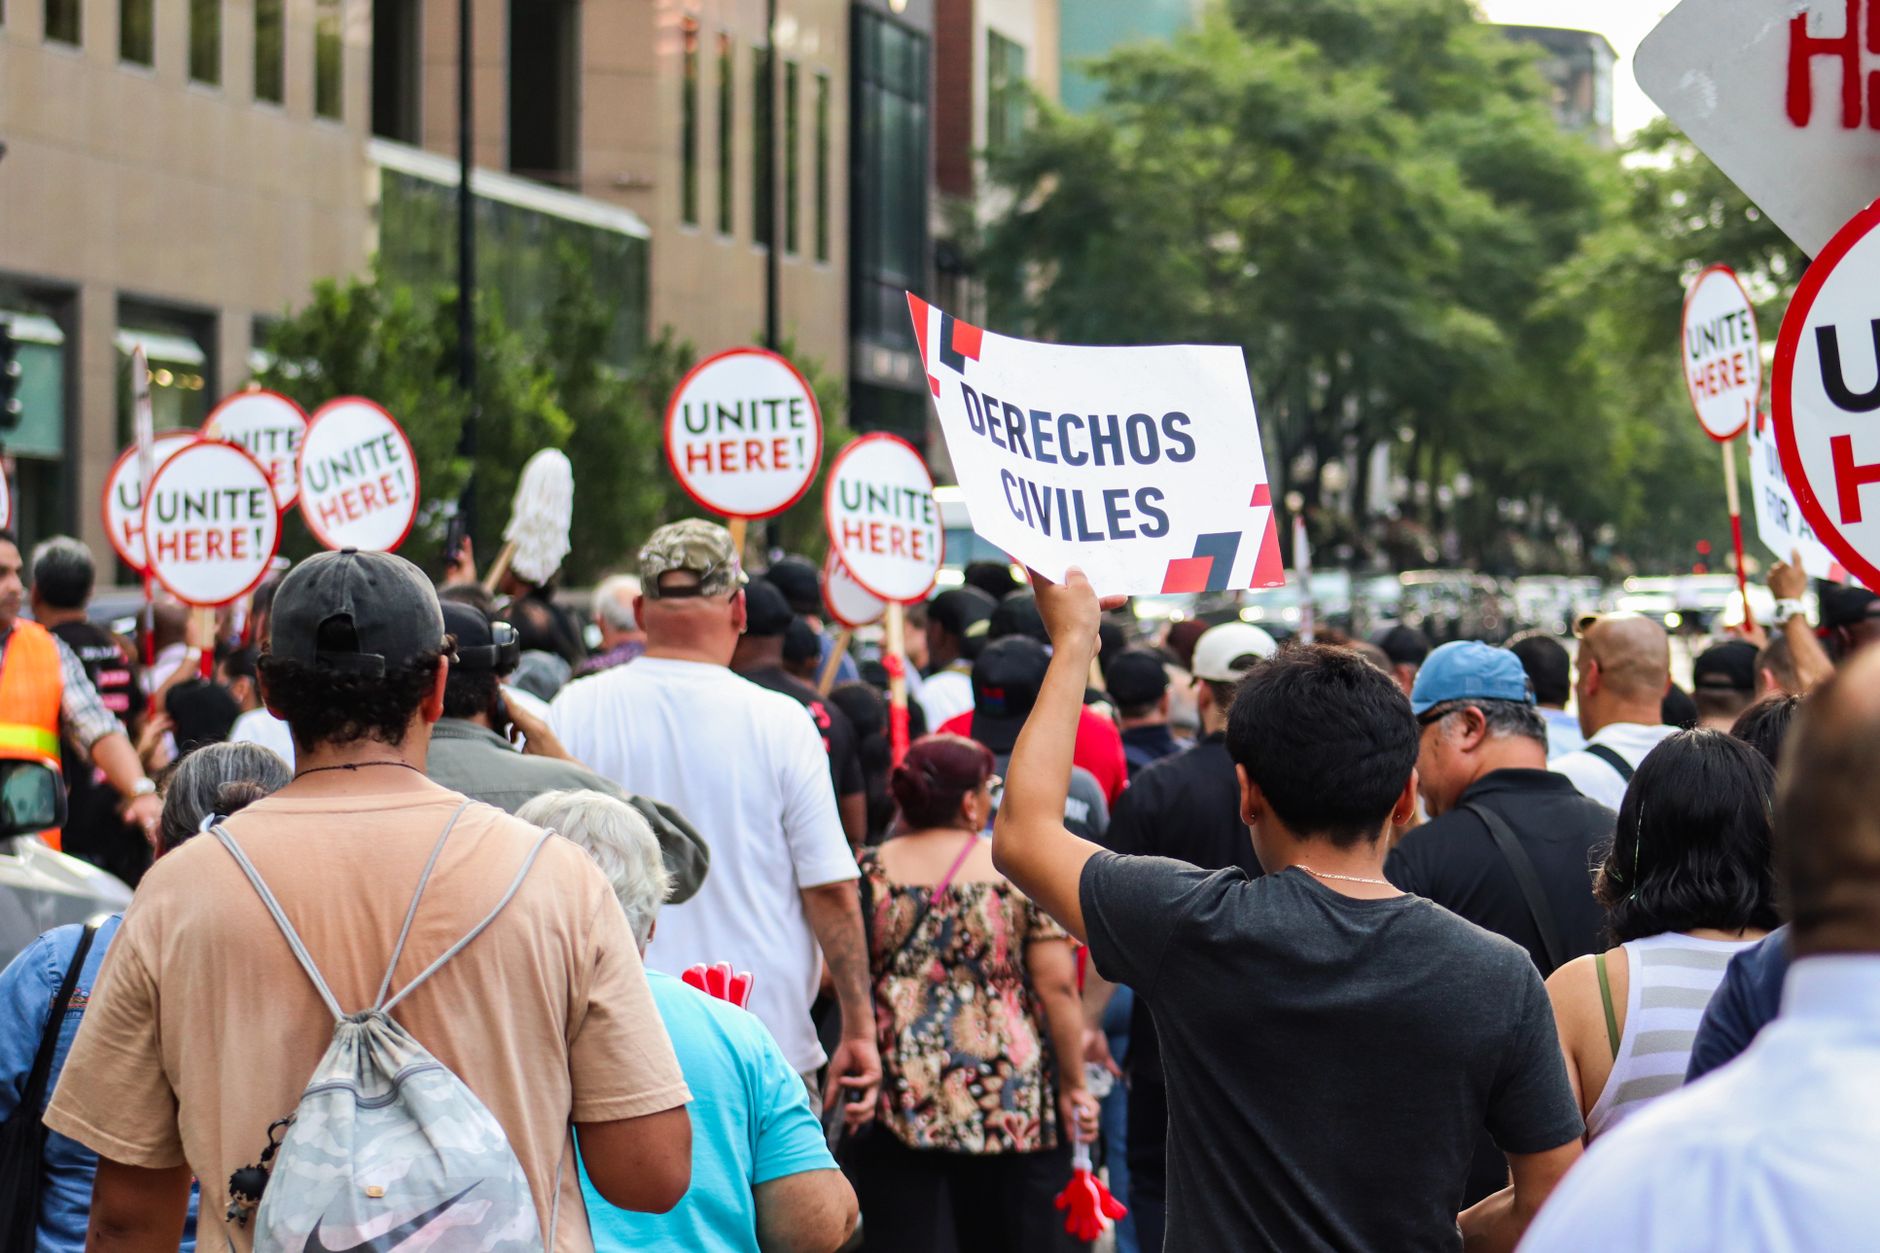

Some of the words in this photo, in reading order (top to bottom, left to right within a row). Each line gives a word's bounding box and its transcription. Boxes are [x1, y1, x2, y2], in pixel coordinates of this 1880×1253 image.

[1688, 309, 1750, 360] UNITE
[1693, 347, 1755, 400] HERE!
[684, 397, 806, 435] UNITE
[960, 381, 1196, 466] DERECHOS
[306, 432, 401, 493] UNITE
[686, 437, 806, 475] HERE!
[156, 487, 268, 523] UNITE
[318, 467, 410, 529] HERE!
[839, 479, 935, 525] UNITE
[1000, 468, 1170, 542] CIVILES
[157, 526, 264, 563] HERE!
[842, 520, 935, 565] HERE!
